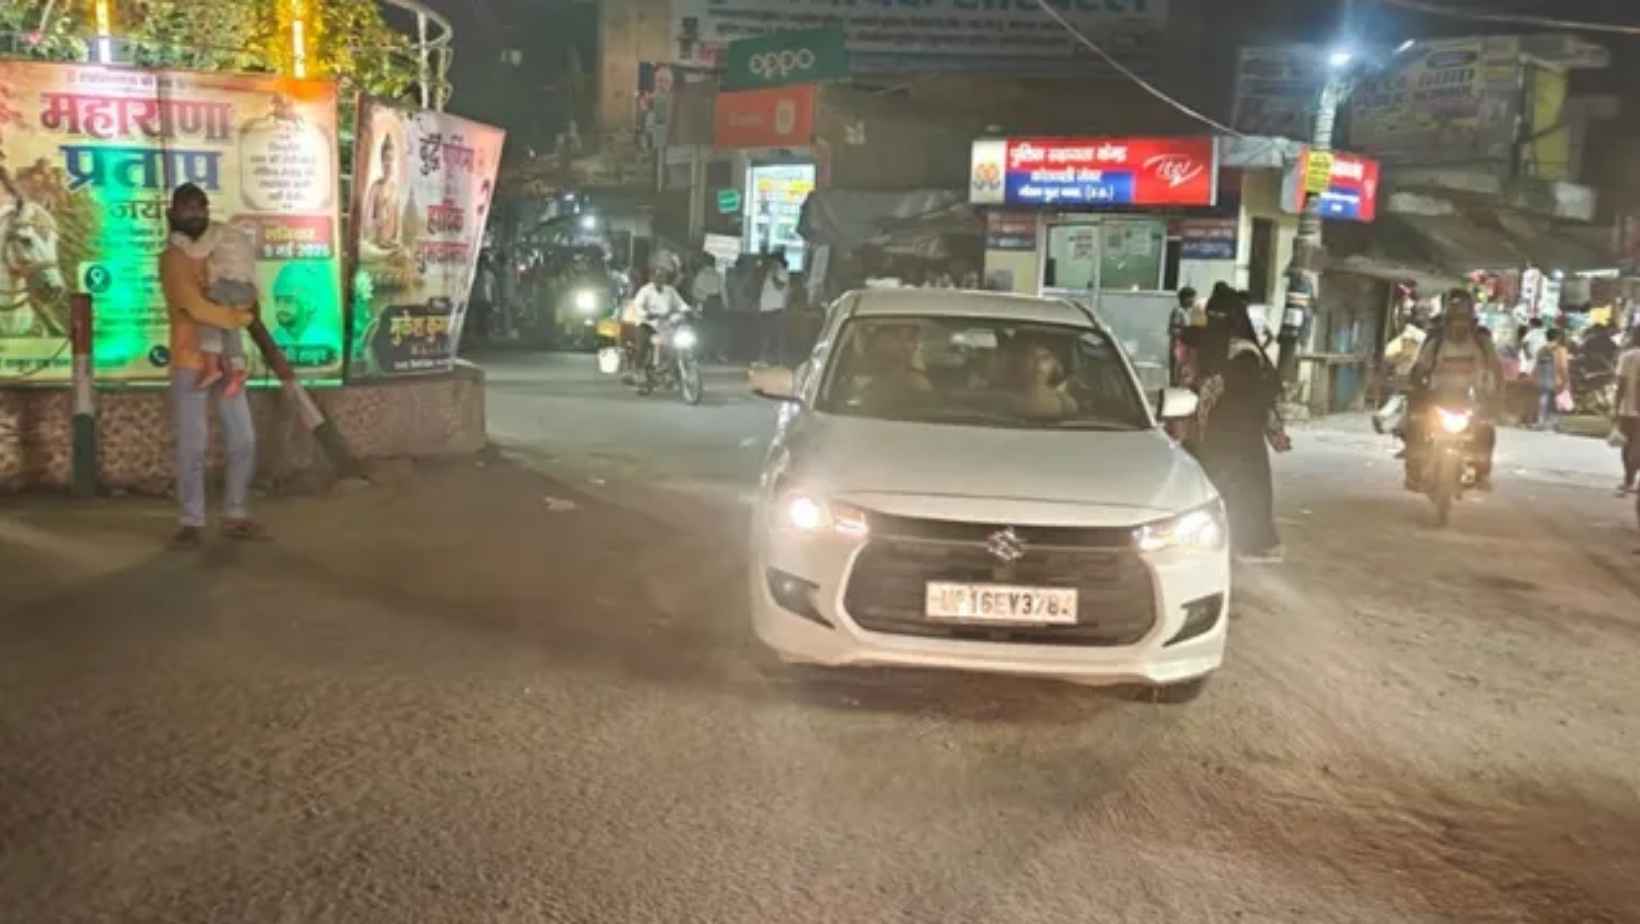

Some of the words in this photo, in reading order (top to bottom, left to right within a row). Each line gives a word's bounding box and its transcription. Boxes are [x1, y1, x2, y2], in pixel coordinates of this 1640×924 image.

[749, 48, 816, 79] oppo
[39, 92, 232, 140] महाराणा
[58, 144, 223, 191] प्रताप
